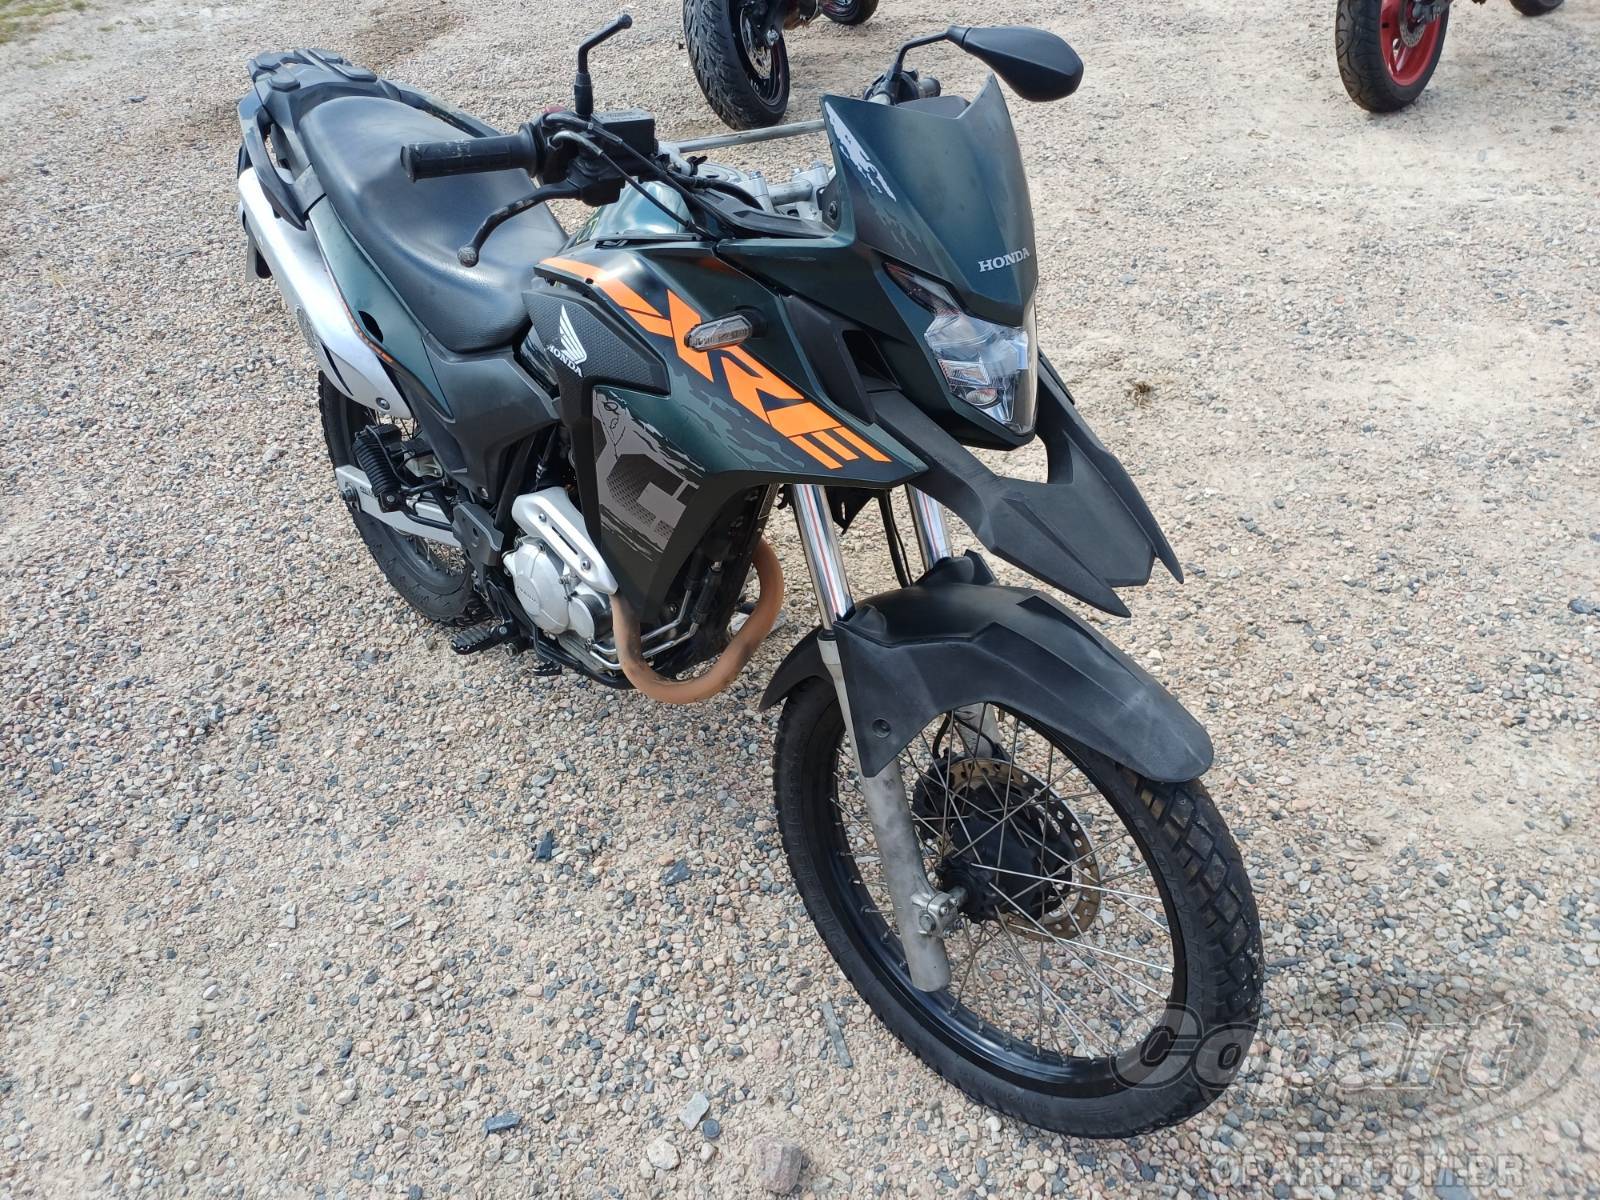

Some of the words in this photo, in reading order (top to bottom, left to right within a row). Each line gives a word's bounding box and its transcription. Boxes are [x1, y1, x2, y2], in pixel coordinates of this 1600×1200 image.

[978, 247, 1031, 273] HONDA
[545, 342, 584, 378] HONDA
[588, 270, 893, 470] XRE
